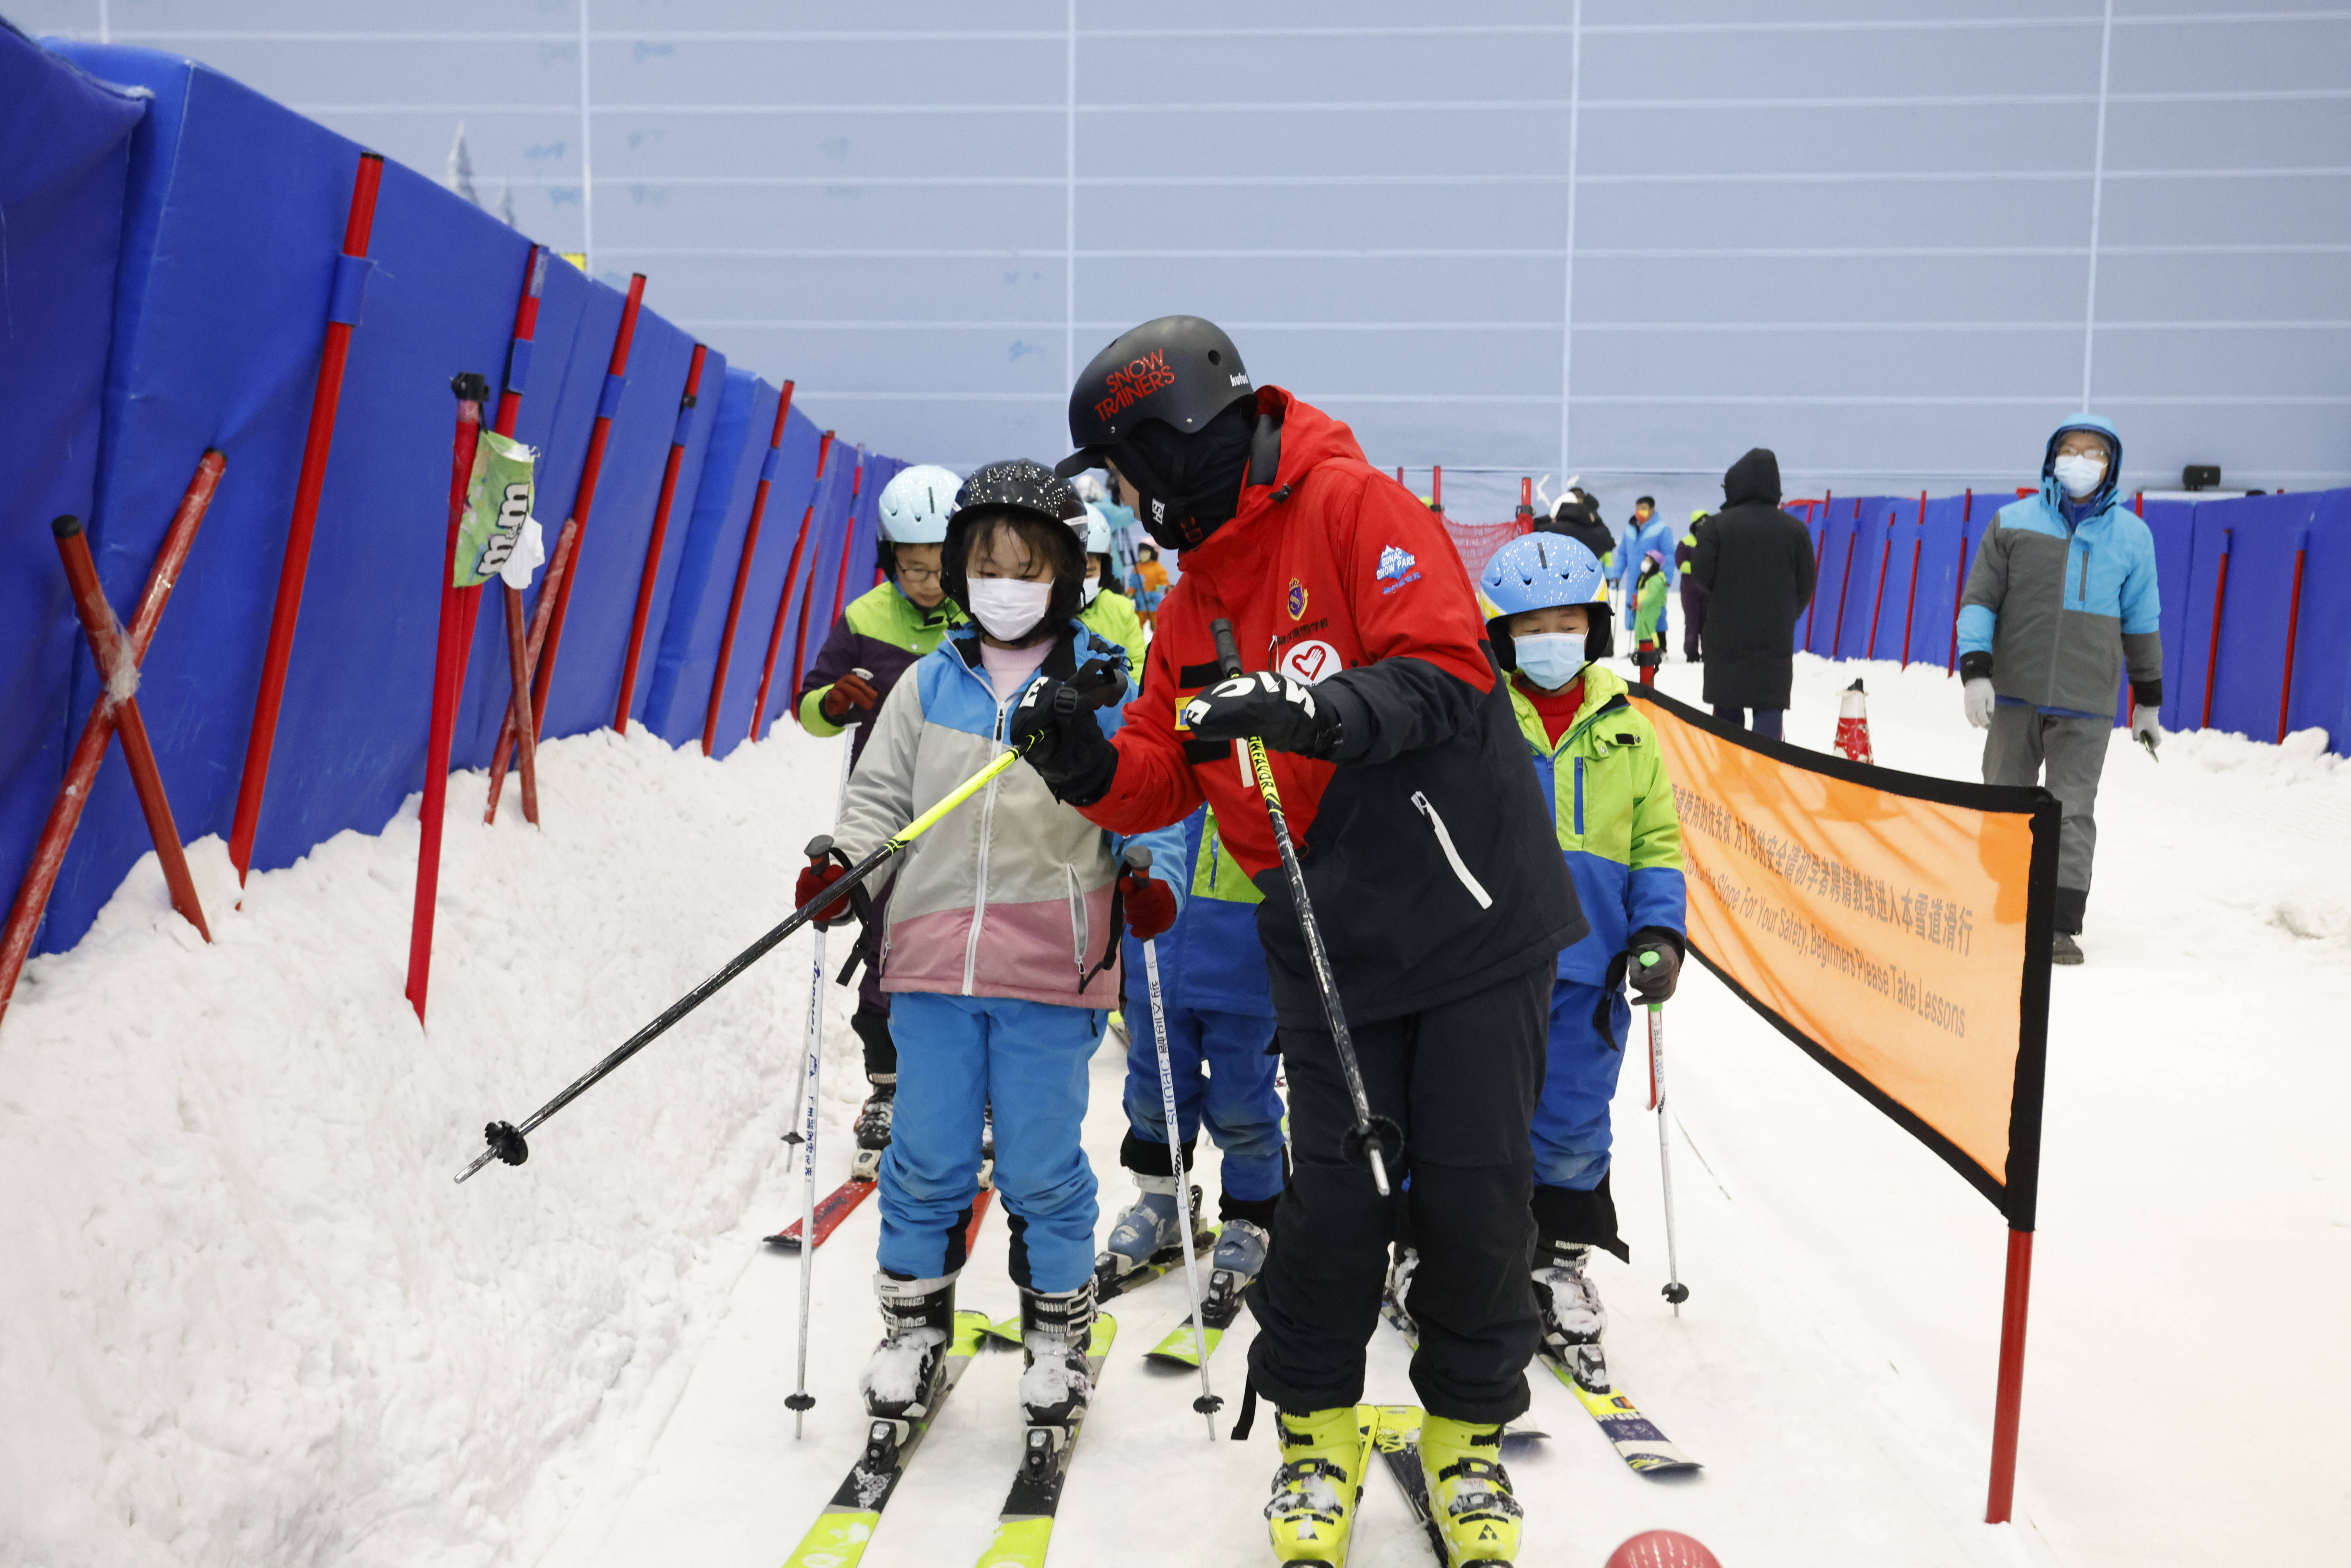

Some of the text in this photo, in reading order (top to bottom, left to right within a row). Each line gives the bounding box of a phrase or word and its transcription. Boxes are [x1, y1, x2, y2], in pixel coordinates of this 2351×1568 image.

[1094, 365, 1175, 422] TRAINERS
[1106, 348, 1164, 394] SNOW
[1376, 555, 1416, 580] SNOW PARK
[1381, 551, 1402, 567] SUNAC
[1734, 816, 1973, 957] 为了您的安全请初学者聘请教练进入本雪道滑行
[1717, 873, 1740, 912] Slope
[1739, 886, 1758, 919] For
[1756, 896, 1778, 934] Your
[1778, 907, 1808, 957] Safety,
[1810, 923, 1856, 977] Beginners
[1855, 947, 1889, 997] Please
[1890, 964, 1916, 1011] Take
[1918, 978, 1966, 1039] Lessons
[1149, 980, 1168, 1054] 融创文旅
[1160, 1059, 1177, 1126] sunac
